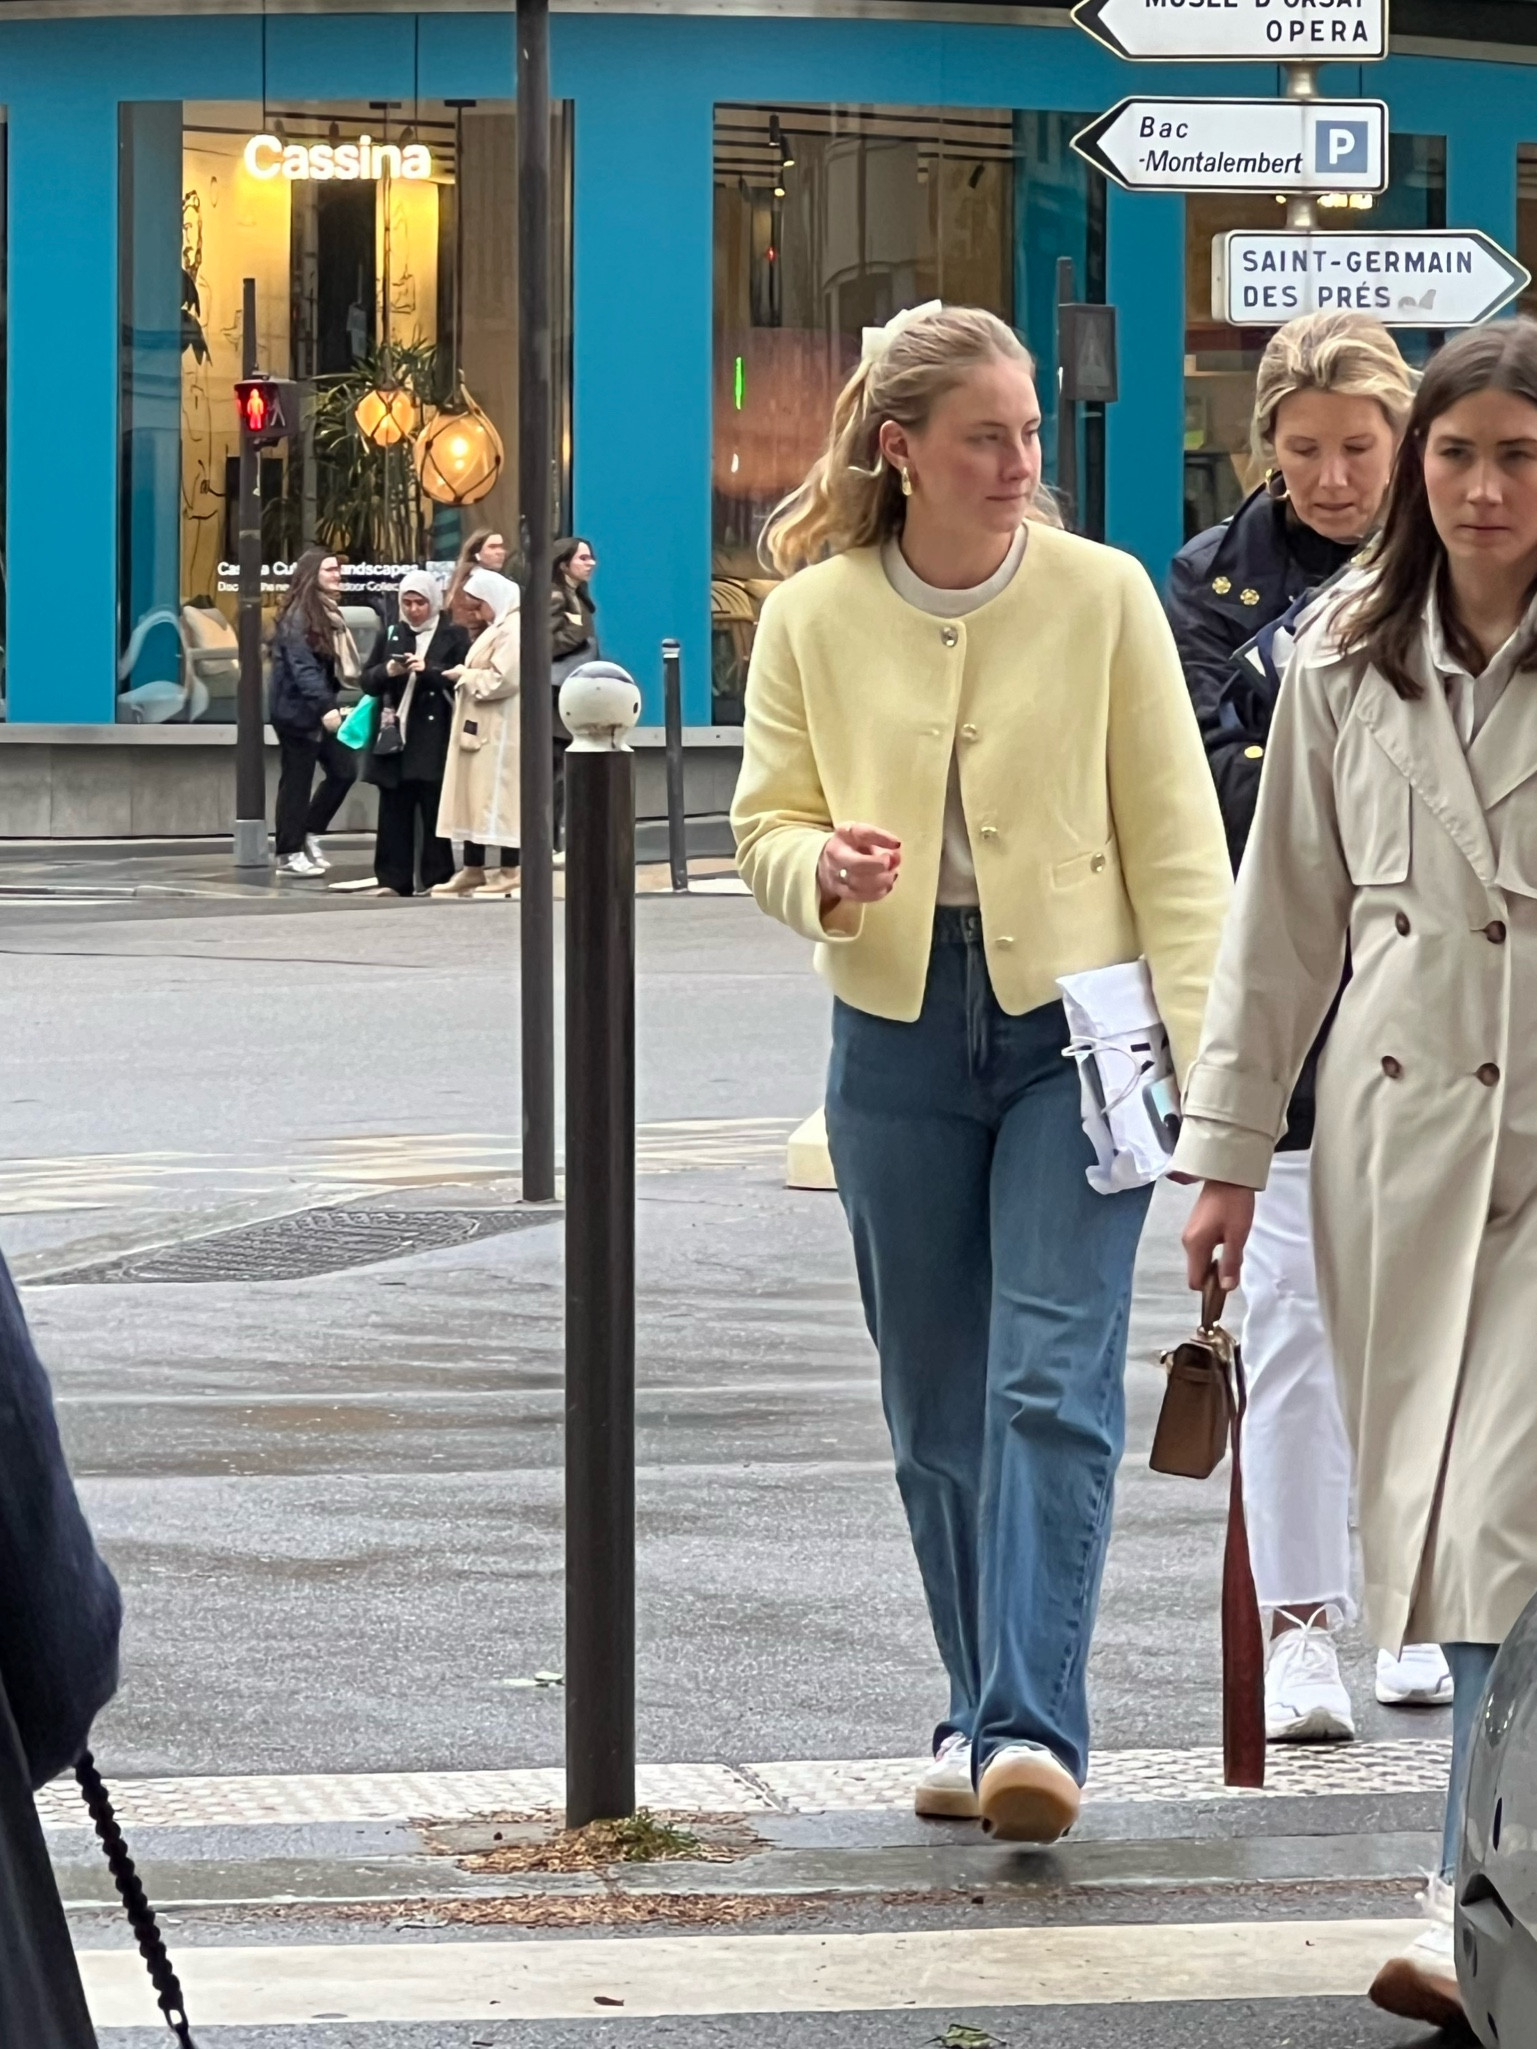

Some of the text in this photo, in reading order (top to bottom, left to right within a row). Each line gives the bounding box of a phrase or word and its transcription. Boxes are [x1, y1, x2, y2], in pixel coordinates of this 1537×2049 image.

[1266, 20, 1369, 42] OPERA
[1139, 117, 1188, 138] Bac
[243, 134, 432, 180] Cassina
[1328, 128, 1355, 165] P
[1138, 152, 1303, 175] -Montalembert
[1242, 250, 1473, 275] SAINT-GERMAIN
[1243, 281, 1391, 309] DES PRÉS
